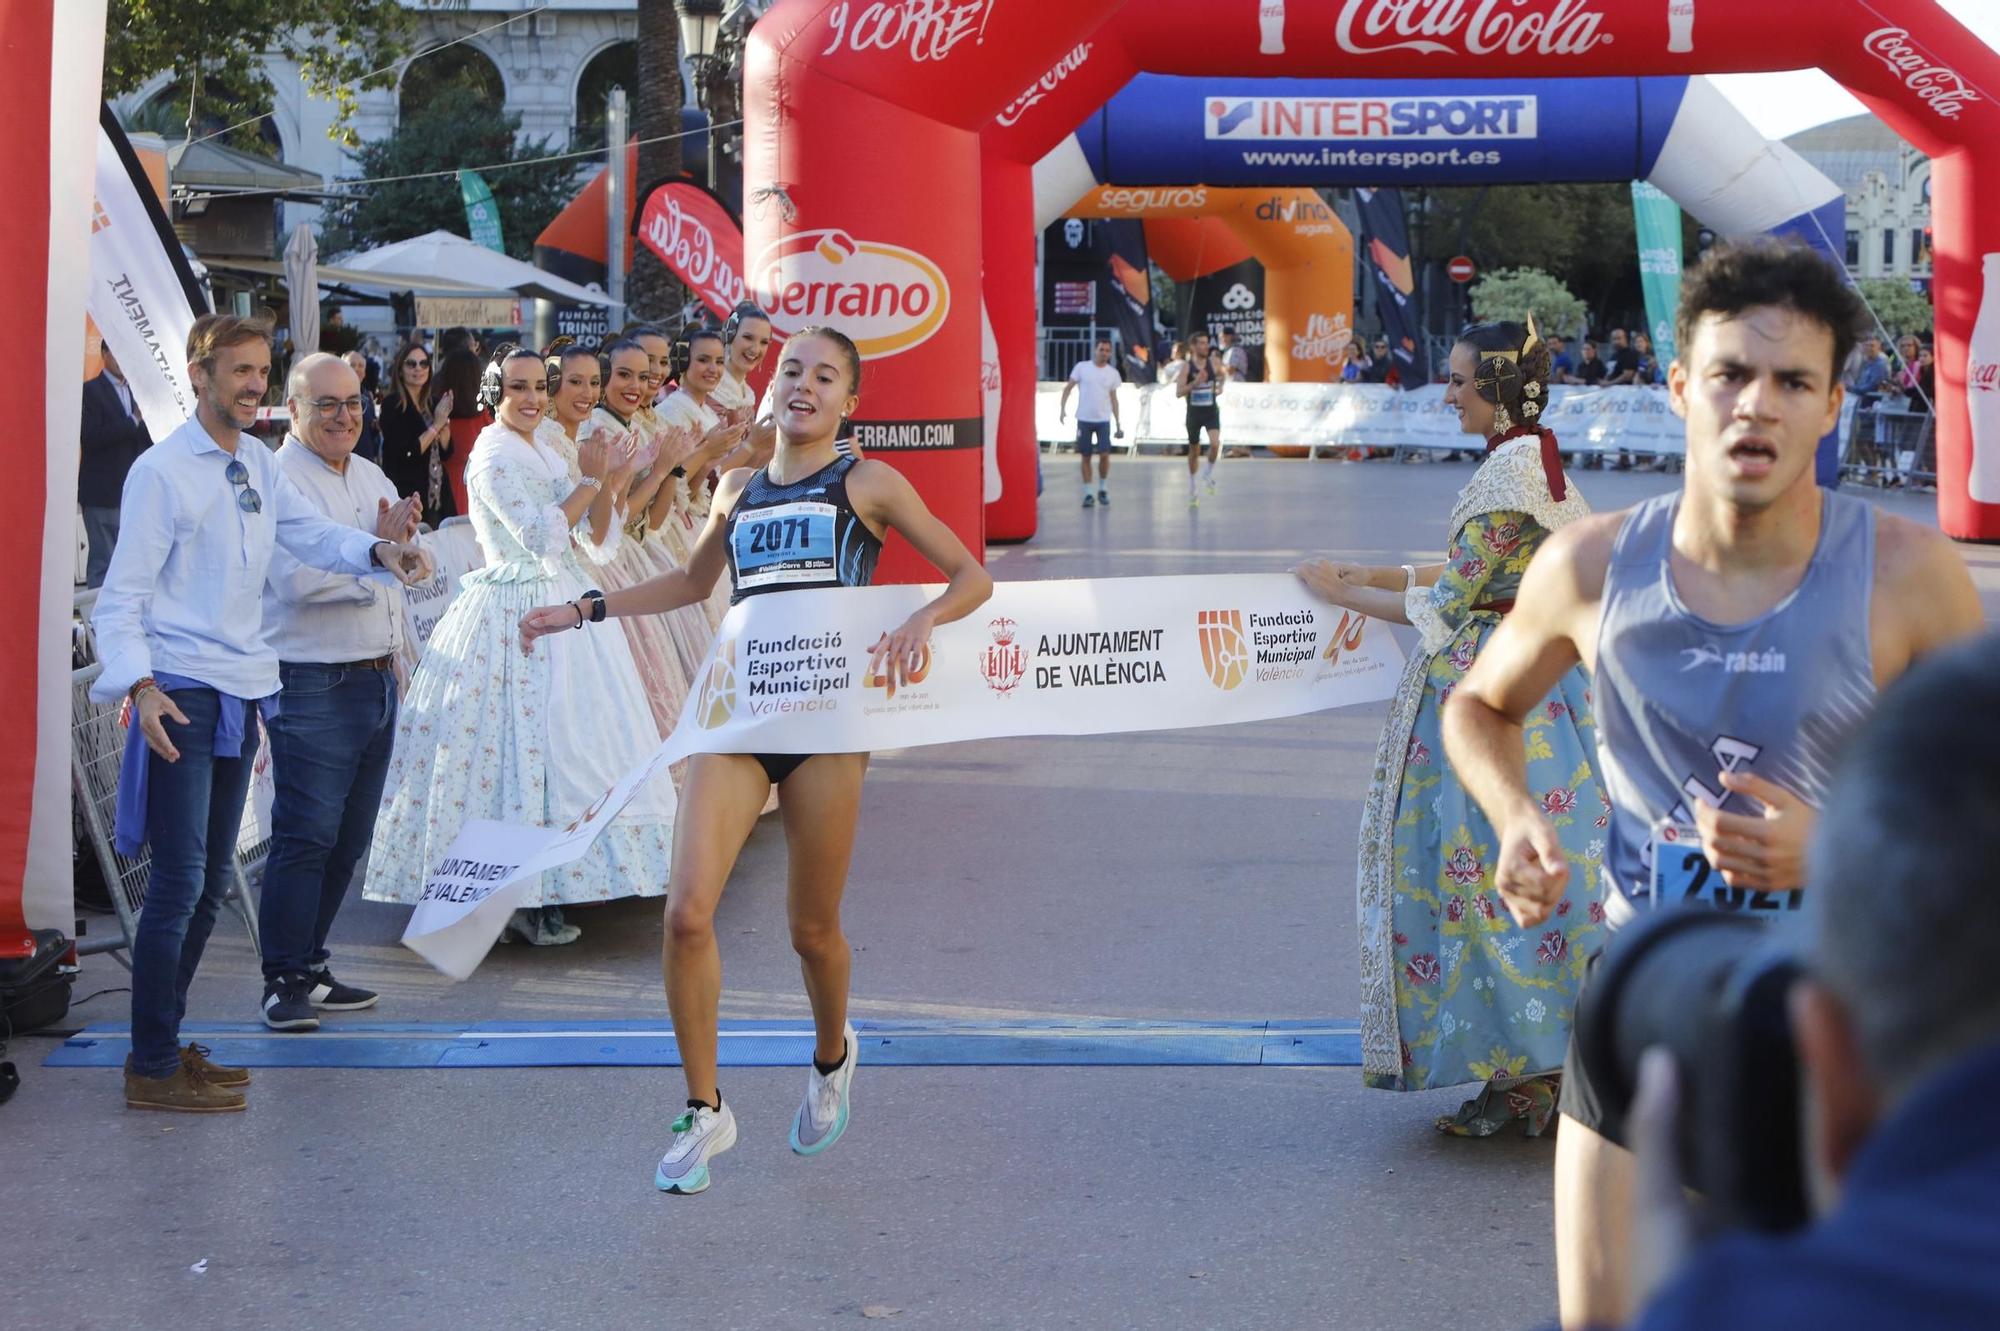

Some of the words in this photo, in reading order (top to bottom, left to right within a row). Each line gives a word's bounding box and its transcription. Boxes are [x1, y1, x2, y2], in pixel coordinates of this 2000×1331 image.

[1261, 100, 1525, 136] INTERSPORT
[1243, 148, 1501, 168] www.intersport.es
[1098, 188, 1207, 212] seguros
[763, 266, 930, 316] Serrano
[558, 311, 608, 320] FUNDAC
[558, 321, 608, 335] TRINID
[854, 424, 954, 447] ERRANO.COM
[750, 517, 810, 554] 2071
[1250, 610, 1313, 627] Fundació
[747, 631, 842, 656] Fundació
[1037, 629, 1164, 656] AJUNTAMENT
[1254, 629, 1317, 648] Esportiva
[748, 655, 847, 679] Esportiva
[1256, 646, 1316, 665] Municipal
[1724, 646, 1786, 673] rasán
[749, 672, 850, 697] Municipal
[1036, 666, 1063, 689] DE
[1069, 657, 1166, 687] VALÈNCIA
[1256, 667, 1303, 682] València
[750, 697, 838, 717] València
